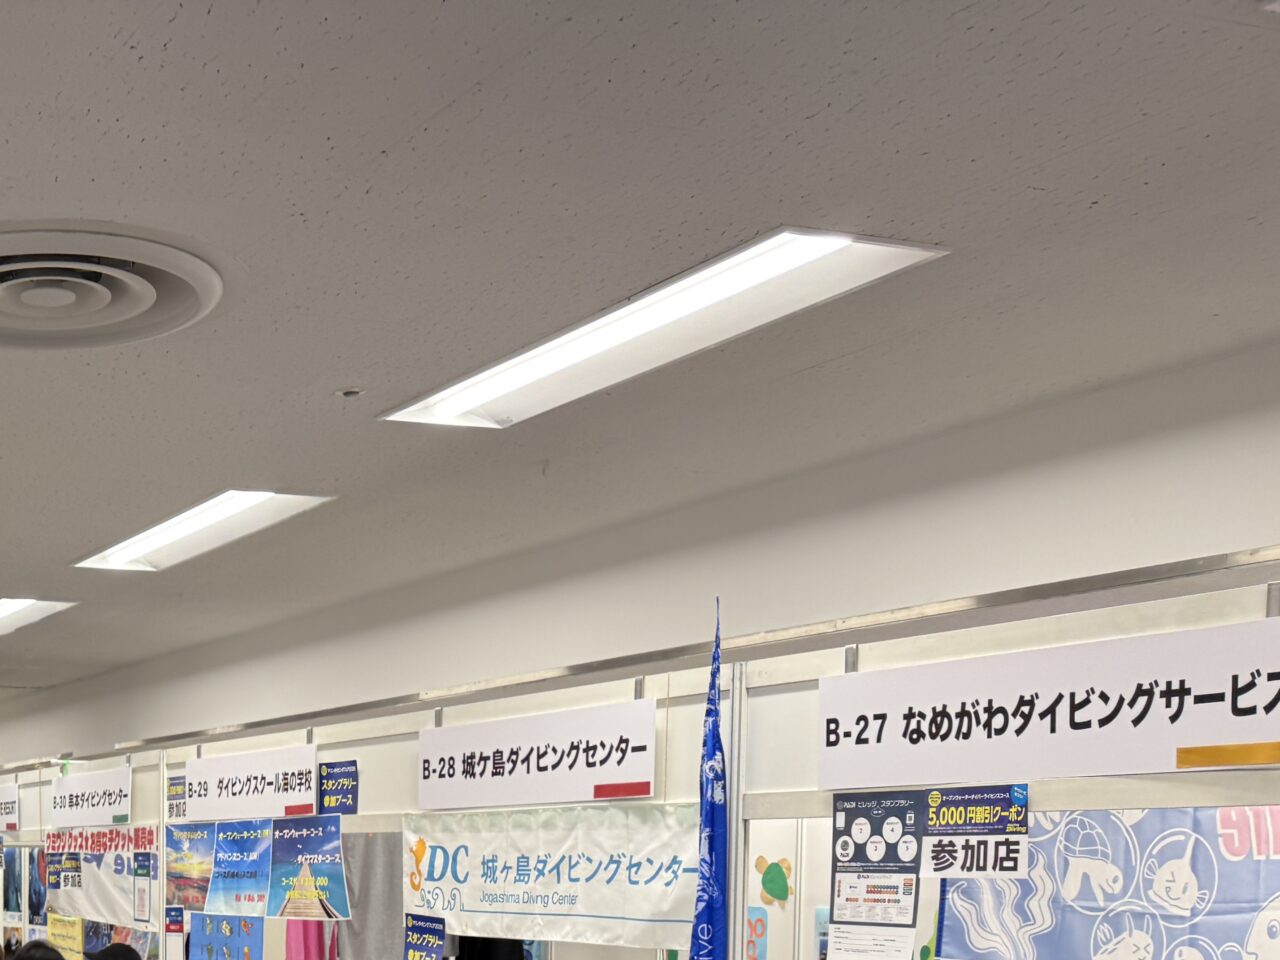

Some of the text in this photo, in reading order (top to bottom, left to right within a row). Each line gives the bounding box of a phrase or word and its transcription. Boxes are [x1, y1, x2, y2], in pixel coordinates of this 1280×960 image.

[825, 668, 1280, 747] B-27 なめがわダイビングサービス
[423, 735, 647, 780] B-28 城ケ島ダイビングセンター
[188, 768, 313, 799] B-29 ダイビングスクール海の学校
[321, 779, 357, 790] スタンプラリー
[931, 837, 1020, 872] 参加店
[479, 890, 520, 905] Jogashima
[551, 893, 578, 905] Center
[406, 930, 444, 947] スタンプラリー
